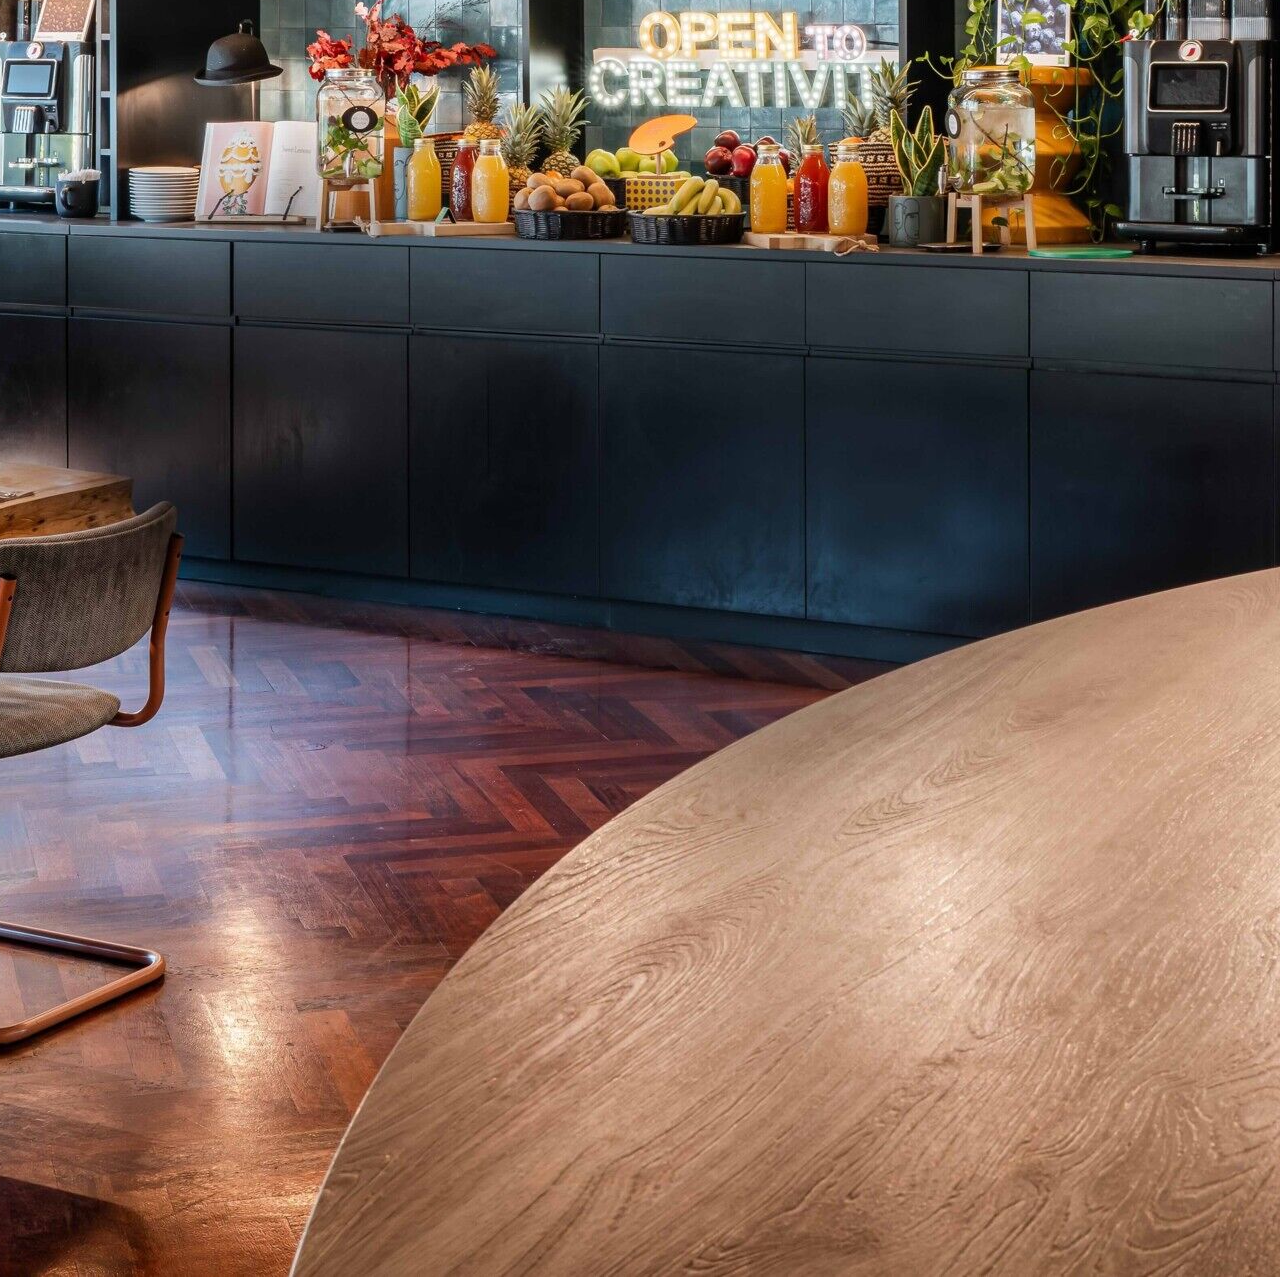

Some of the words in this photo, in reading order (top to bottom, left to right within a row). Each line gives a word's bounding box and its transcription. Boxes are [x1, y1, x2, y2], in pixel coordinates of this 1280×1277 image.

[638, 10, 798, 60] OPEN
[804, 23, 867, 61] TO
[588, 55, 888, 109] CREATIVIT
